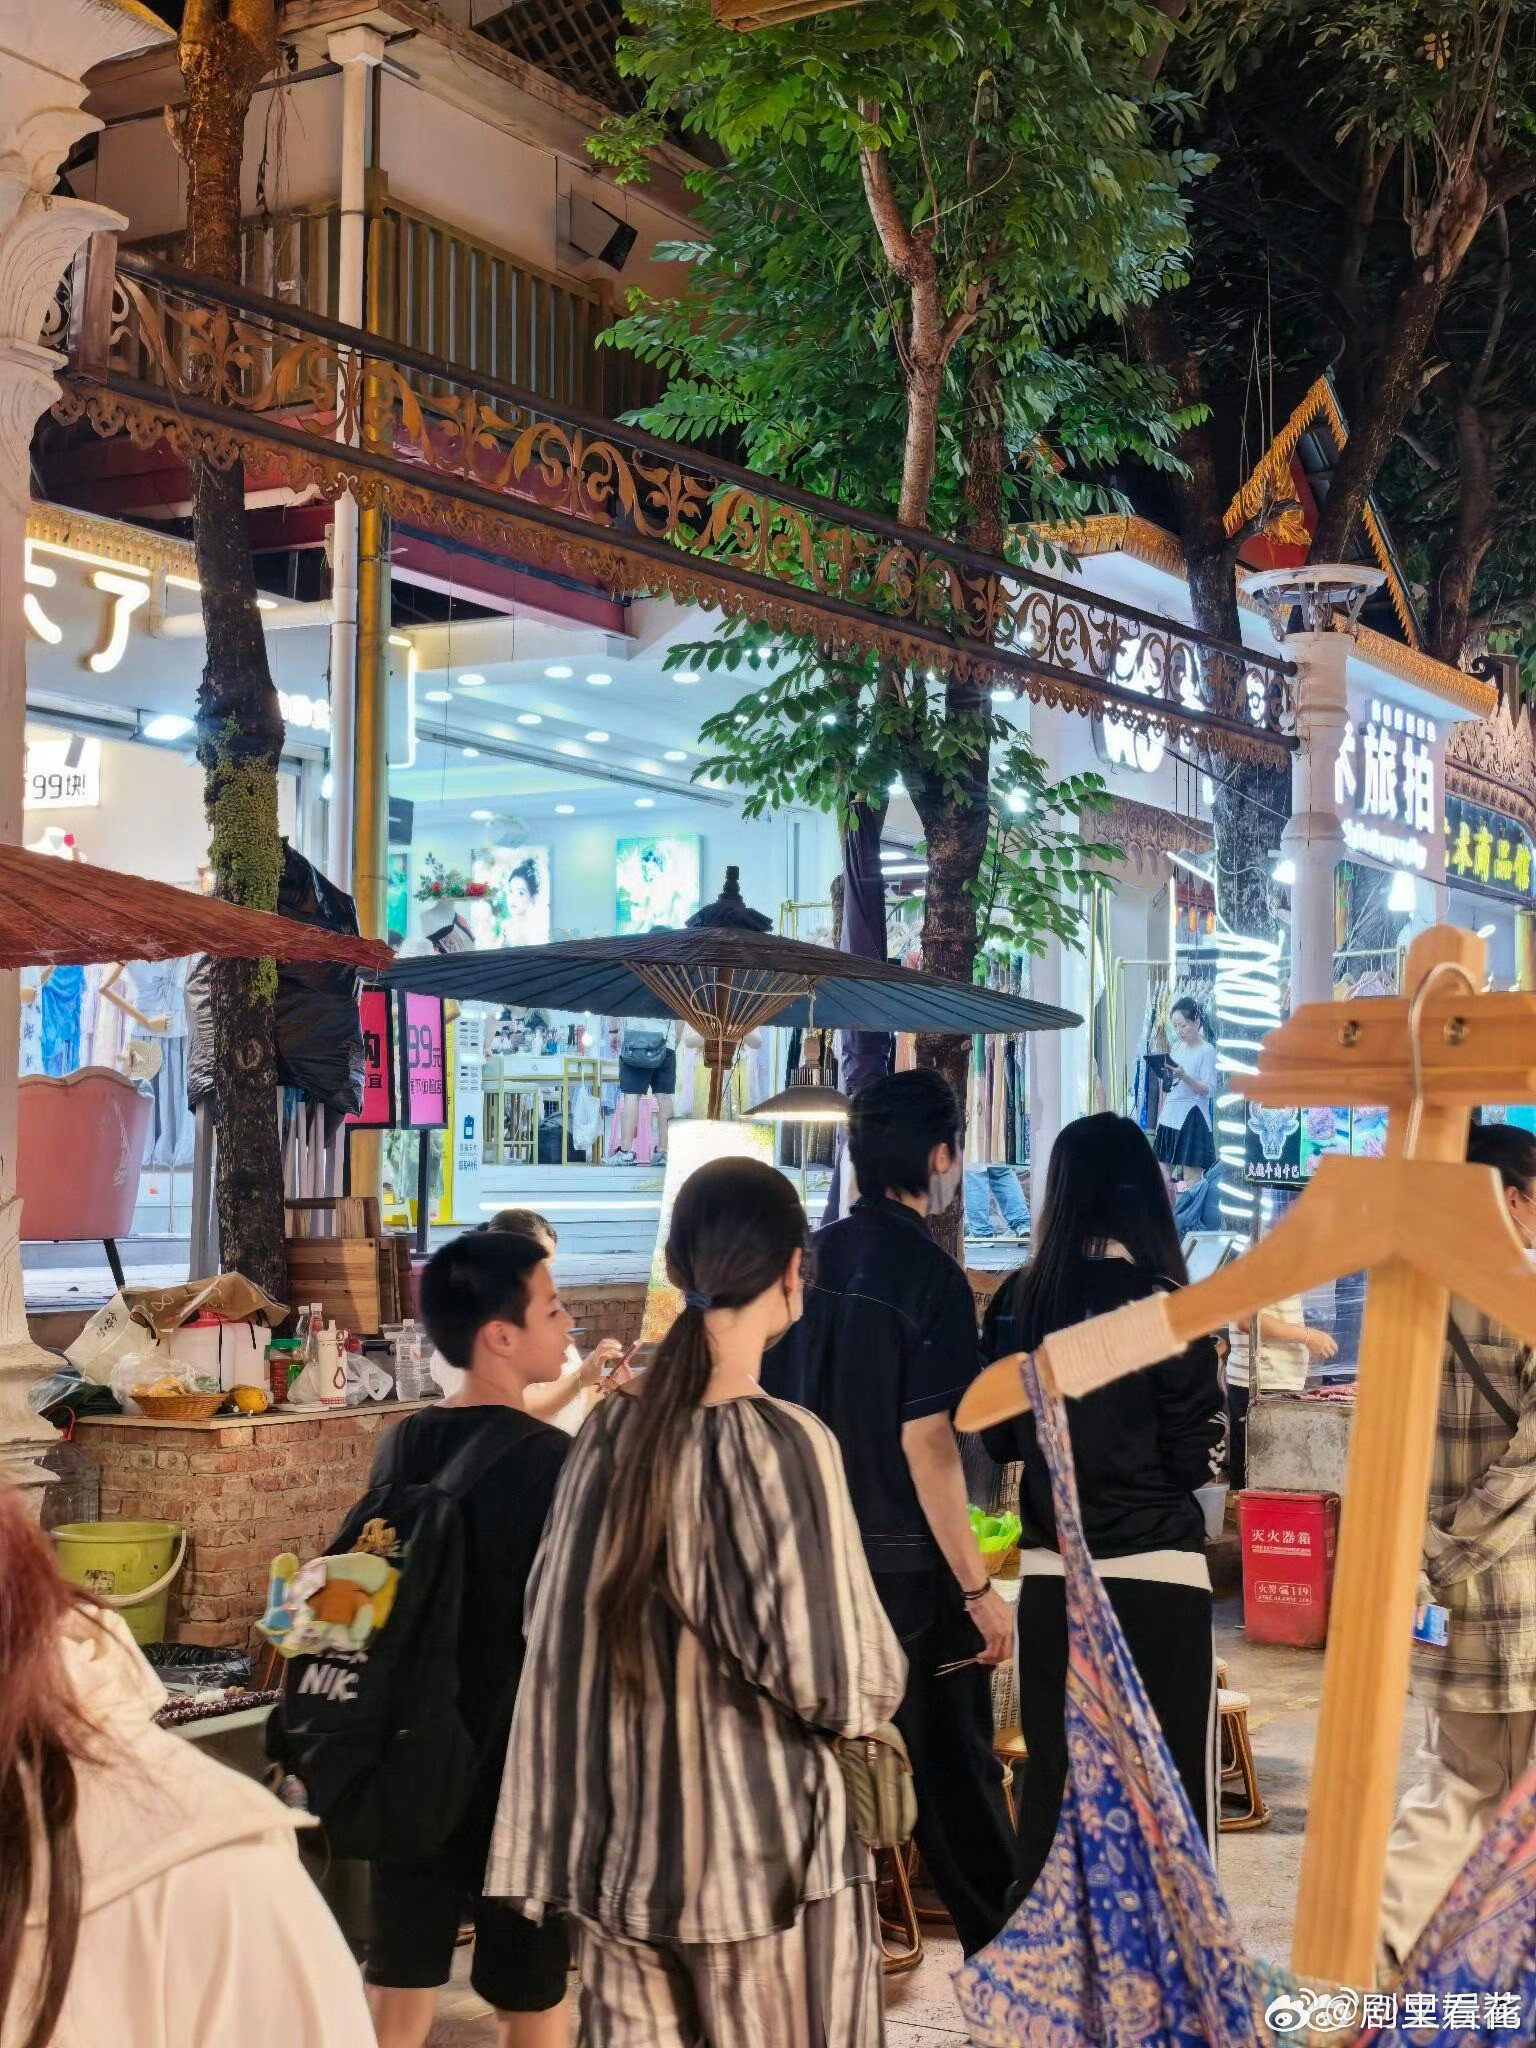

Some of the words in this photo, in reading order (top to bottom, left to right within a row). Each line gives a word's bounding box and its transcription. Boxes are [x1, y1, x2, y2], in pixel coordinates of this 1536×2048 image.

[1251, 1529, 1311, 1545] 灭火器箱
[1291, 1586, 1309, 1596] 119
[297, 1663, 360, 1702] NIK
